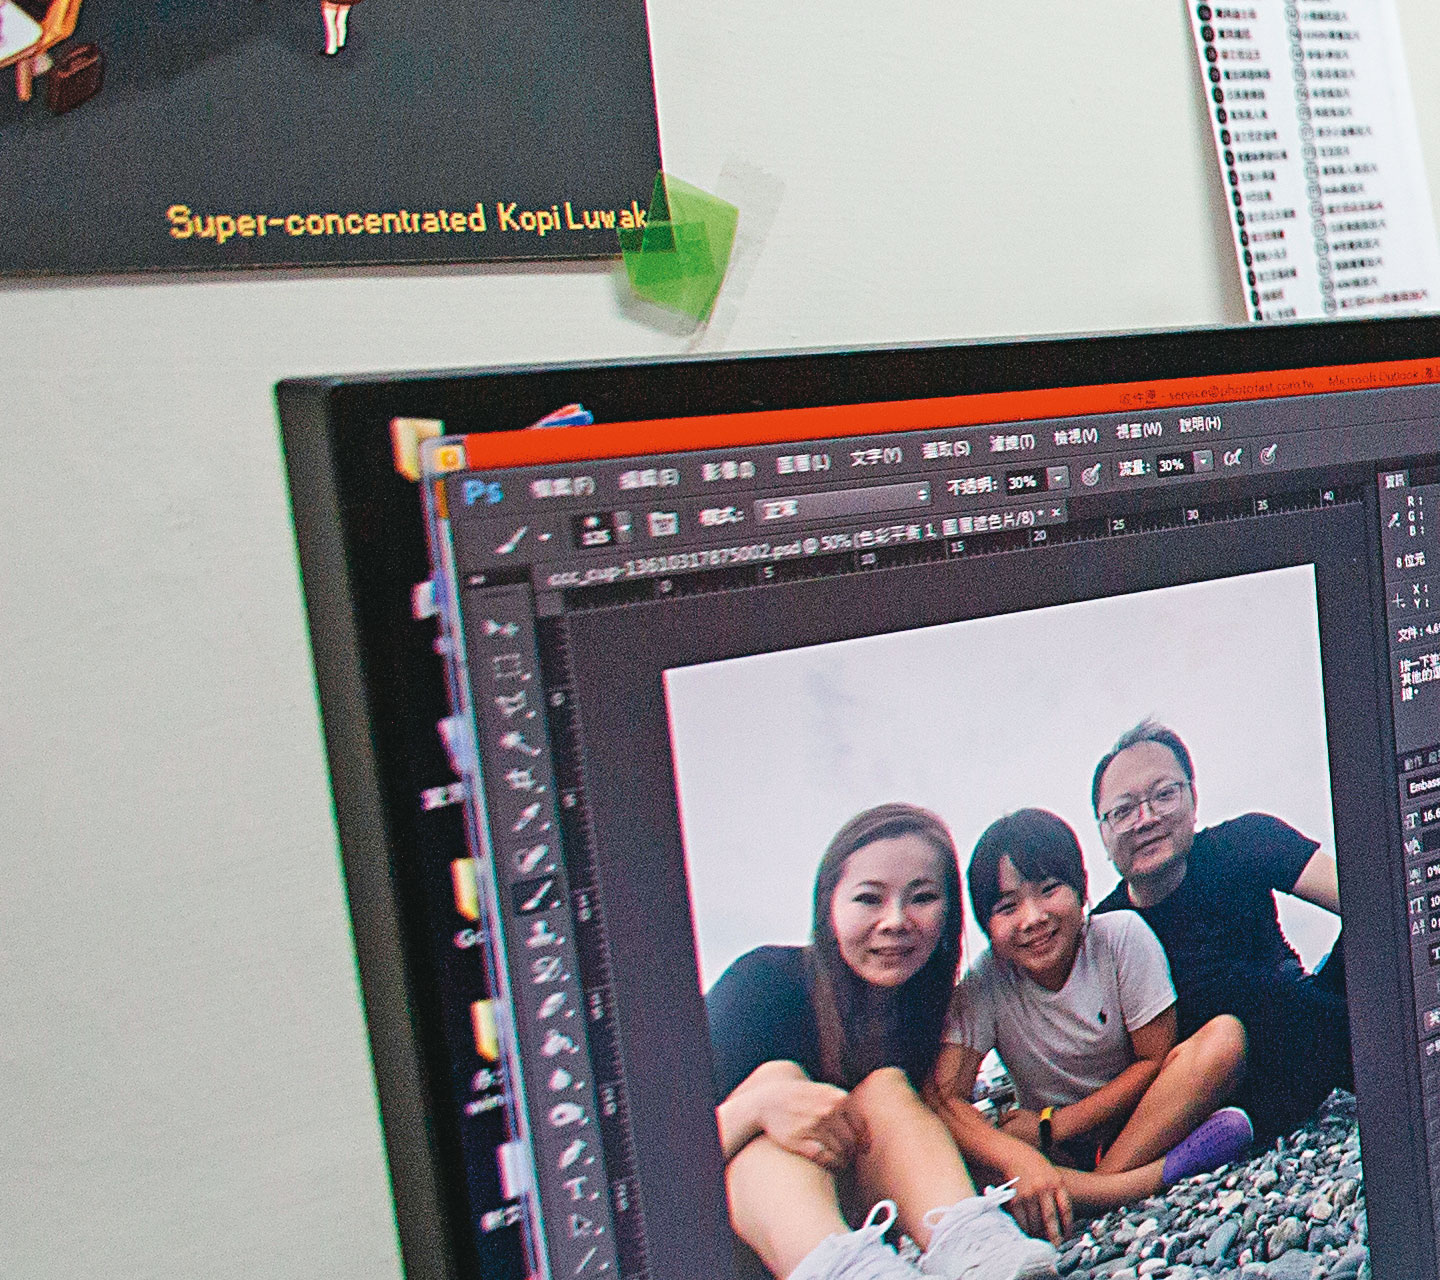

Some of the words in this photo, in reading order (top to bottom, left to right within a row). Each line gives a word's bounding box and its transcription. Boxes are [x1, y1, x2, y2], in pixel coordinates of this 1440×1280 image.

[167, 203, 487, 243] Super-concentrated
[497, 202, 558, 236] Kopi
[567, 200, 648, 230] Luwak
[850, 446, 903, 468] 文字(Y)
[1007, 473, 1038, 491] 30%
[1158, 456, 1186, 473] 30%
[463, 479, 504, 506] Ps
